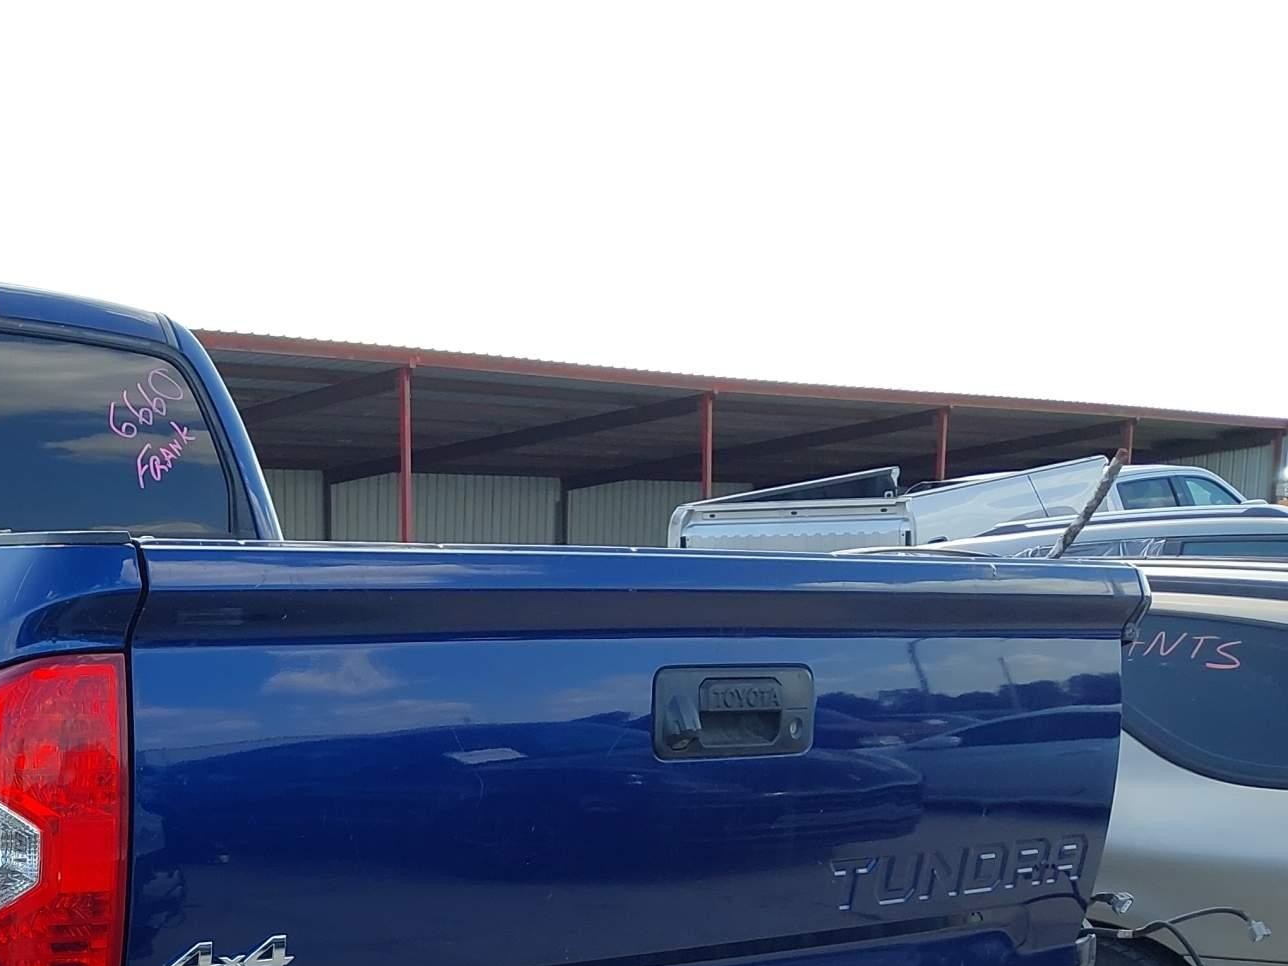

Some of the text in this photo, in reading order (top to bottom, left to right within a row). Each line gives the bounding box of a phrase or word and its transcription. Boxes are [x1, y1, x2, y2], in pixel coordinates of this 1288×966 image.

[108, 367, 184, 439] 6660
[136, 420, 197, 489] FRANK
[713, 687, 780, 709] TOYOTA
[829, 833, 1089, 911] TUNDRA
